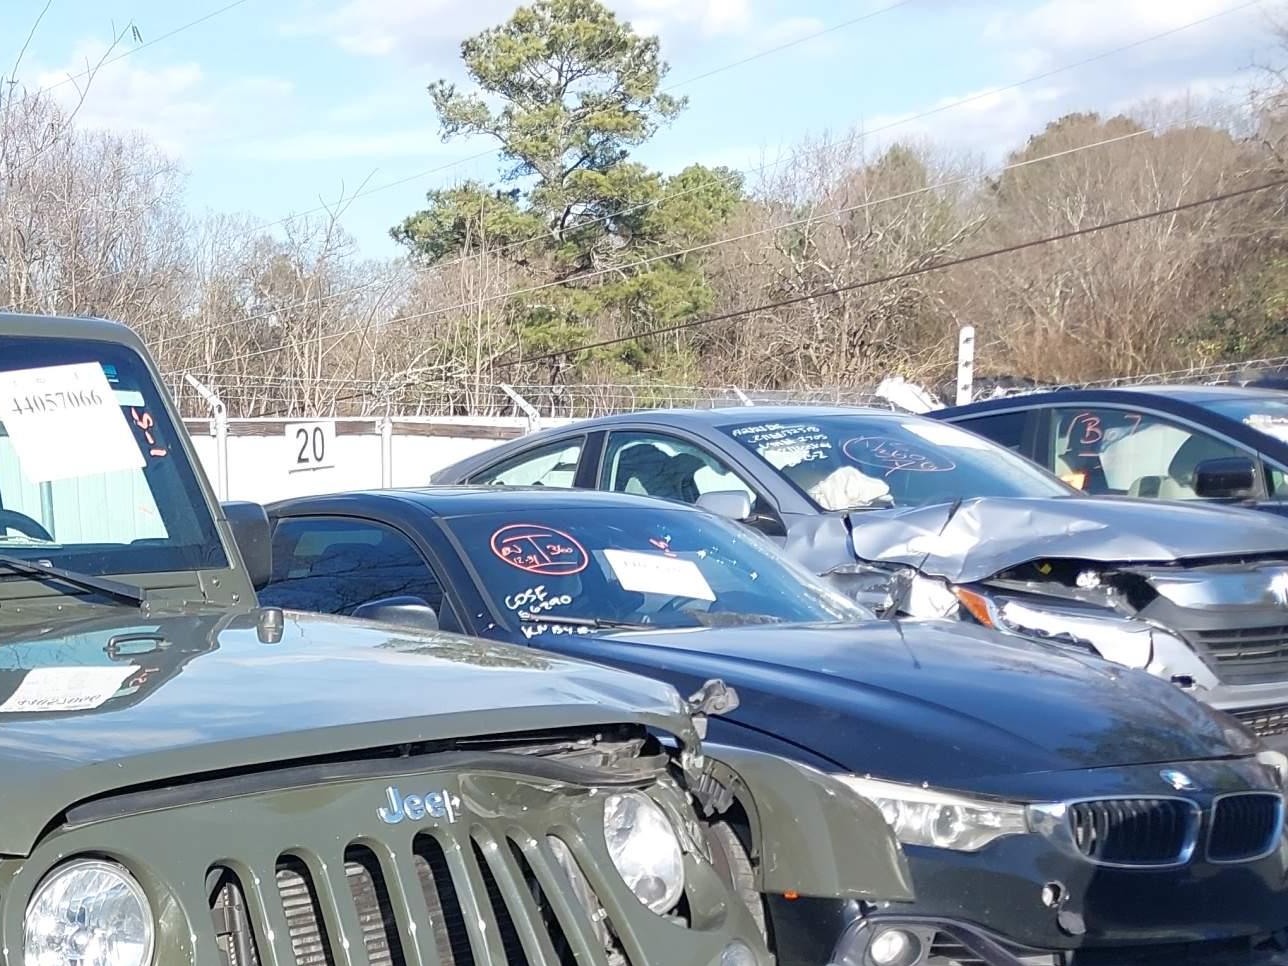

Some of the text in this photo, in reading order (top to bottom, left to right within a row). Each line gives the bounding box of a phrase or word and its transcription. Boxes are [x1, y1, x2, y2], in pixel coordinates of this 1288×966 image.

[12, 388, 104, 416] 44057066
[296, 426, 325, 464] 20
[376, 785, 462, 824] Jeep
